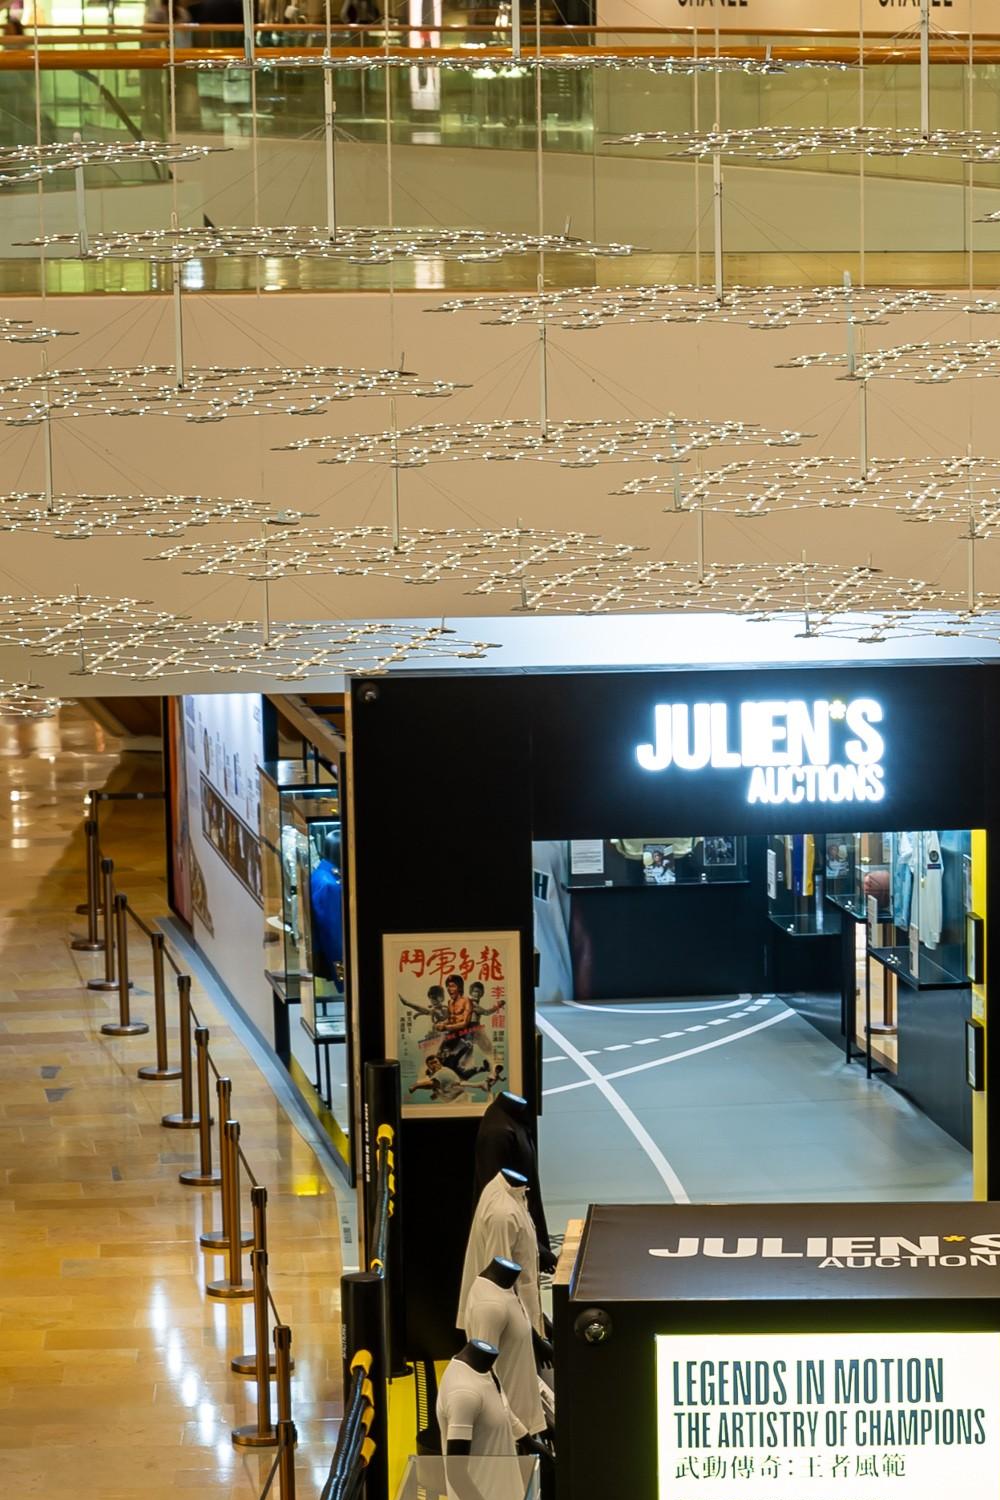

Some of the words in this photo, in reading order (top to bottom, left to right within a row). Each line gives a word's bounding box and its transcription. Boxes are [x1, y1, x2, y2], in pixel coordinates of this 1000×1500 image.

[747, 763, 886, 804] AUCTIONS
[672, 1359, 787, 1406] LEGENDS
[796, 1359, 825, 1405] IN
[834, 1357, 944, 1404] MOTION
[674, 1411, 711, 1448] THE
[717, 1411, 819, 1448] ARTISTRY
[825, 1410, 848, 1447] OF
[855, 1408, 986, 1447] CHAMPIONS
